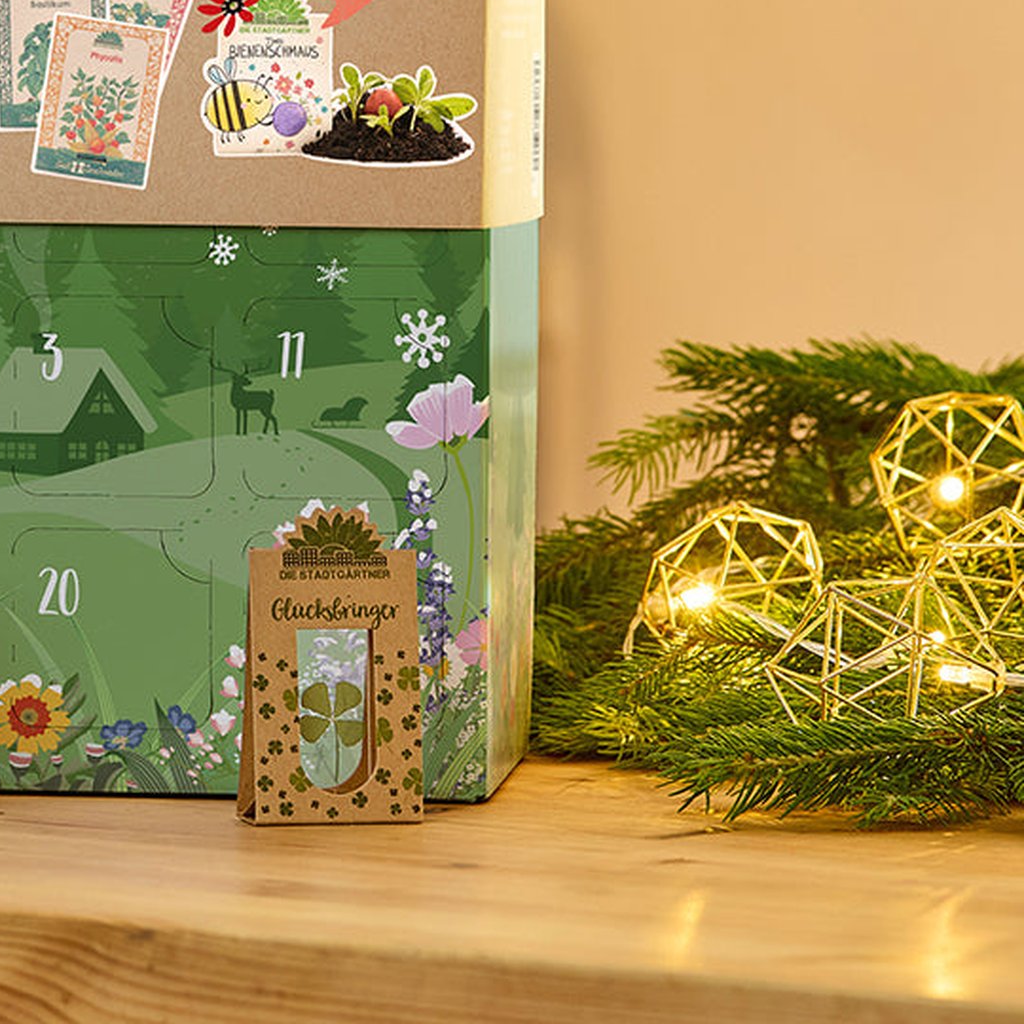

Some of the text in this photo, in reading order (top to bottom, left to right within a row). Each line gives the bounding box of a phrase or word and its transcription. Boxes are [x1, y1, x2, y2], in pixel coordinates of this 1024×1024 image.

[229, 44, 319, 59] BIENENSCHMAUS
[41, 333, 63, 380] 3
[277, 331, 305, 379] 11
[38, 567, 80, 616] 20
[280, 570, 297, 580] DIE
